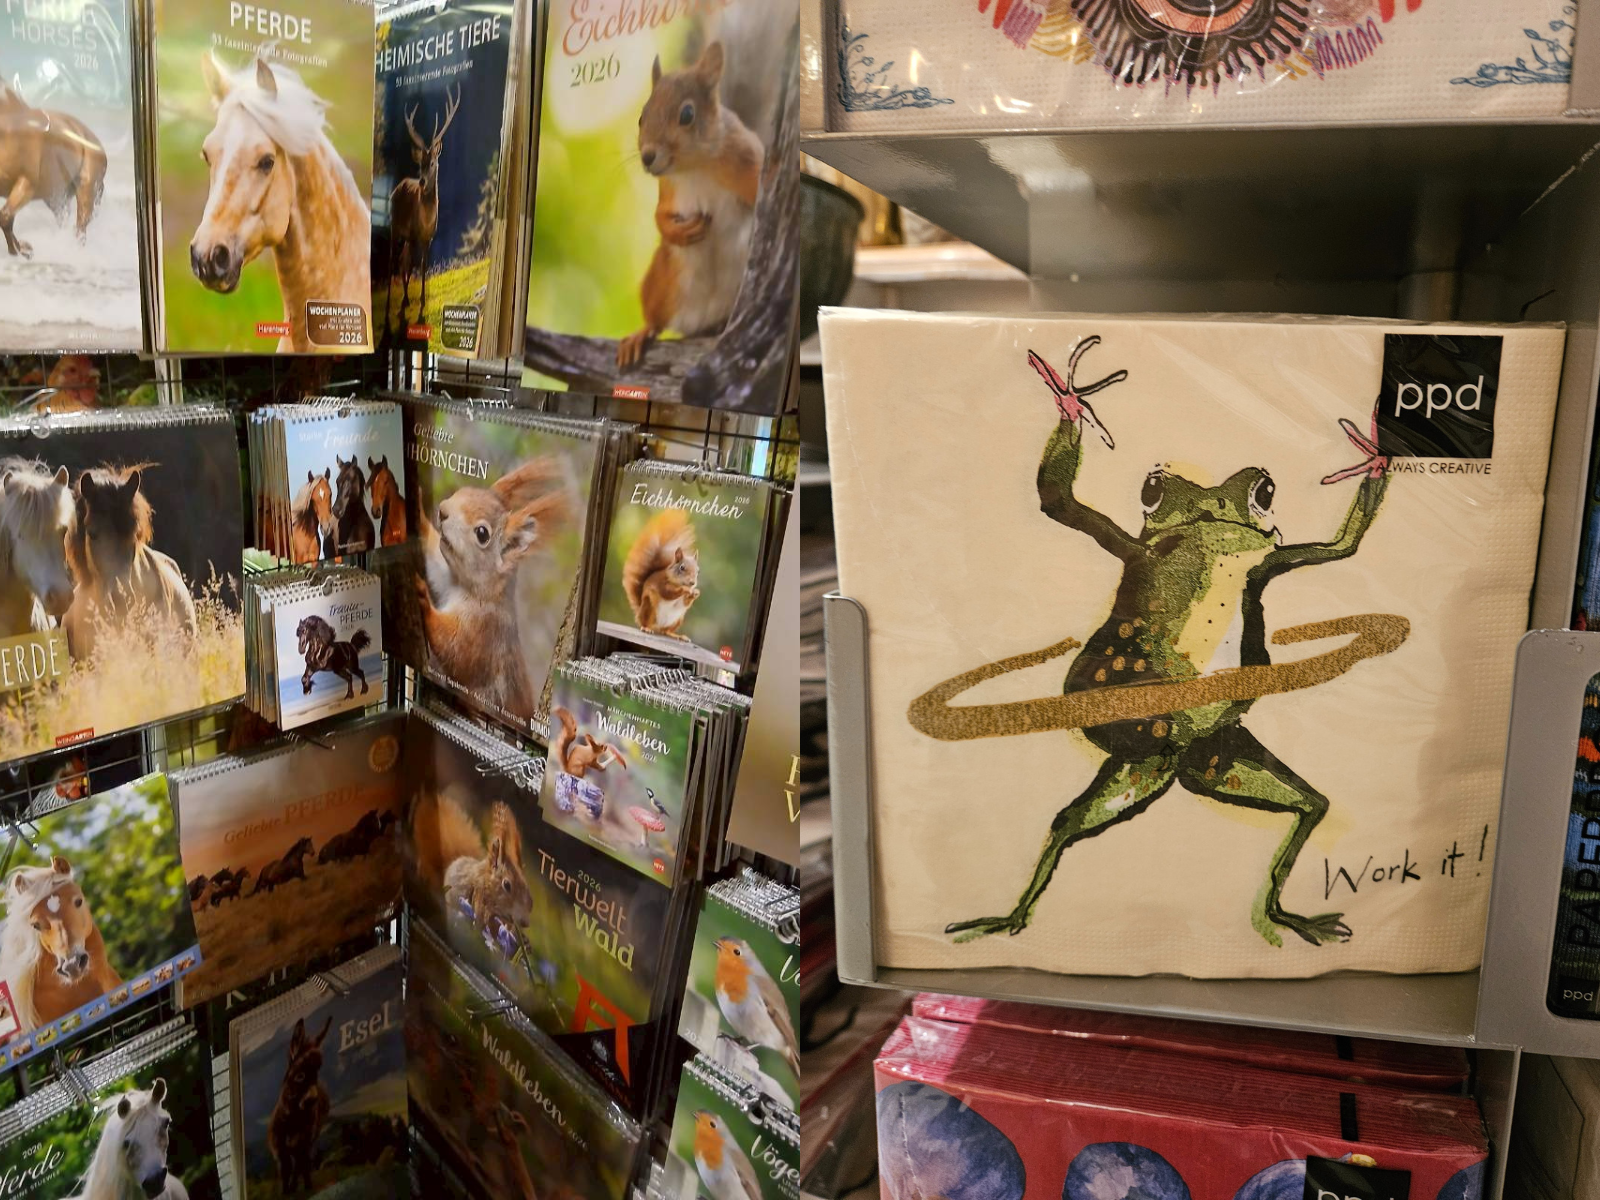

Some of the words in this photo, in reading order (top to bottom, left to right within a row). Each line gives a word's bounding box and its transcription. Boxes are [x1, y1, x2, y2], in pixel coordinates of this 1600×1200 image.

[11, 19, 98, 51] HORSES
[230, 1, 312, 44] PFERDE
[74, 52, 99, 71] 2026
[375, 30, 454, 73] HEIMISCHE
[459, 15, 501, 51] TIERE
[570, 52, 620, 88] 2026
[309, 306, 361, 317] WOCHENPLANER
[339, 332, 363, 343] 2026
[459, 336, 474, 348] 2026
[1393, 375, 1485, 418] ppd
[414, 422, 454, 444] Geliebte
[1375, 461, 1426, 474] ALWAYS
[1429, 462, 1492, 475] CREATIVE
[629, 482, 744, 519] Eichhörnchen
[340, 608, 373, 625] PFERDE
[1, 638, 61, 687] ERDE
[530, 717, 551, 739] DUMO
[596, 710, 671, 756] Waldleben
[538, 848, 627, 935] Tierwelt
[577, 869, 602, 893] 2026
[1324, 848, 1421, 901] Work
[1562, 988, 1594, 1001] ppd
[338, 1000, 392, 1053] Esel
[481, 1022, 567, 1126] Waldleben
[0, 1143, 65, 1197] ferde
